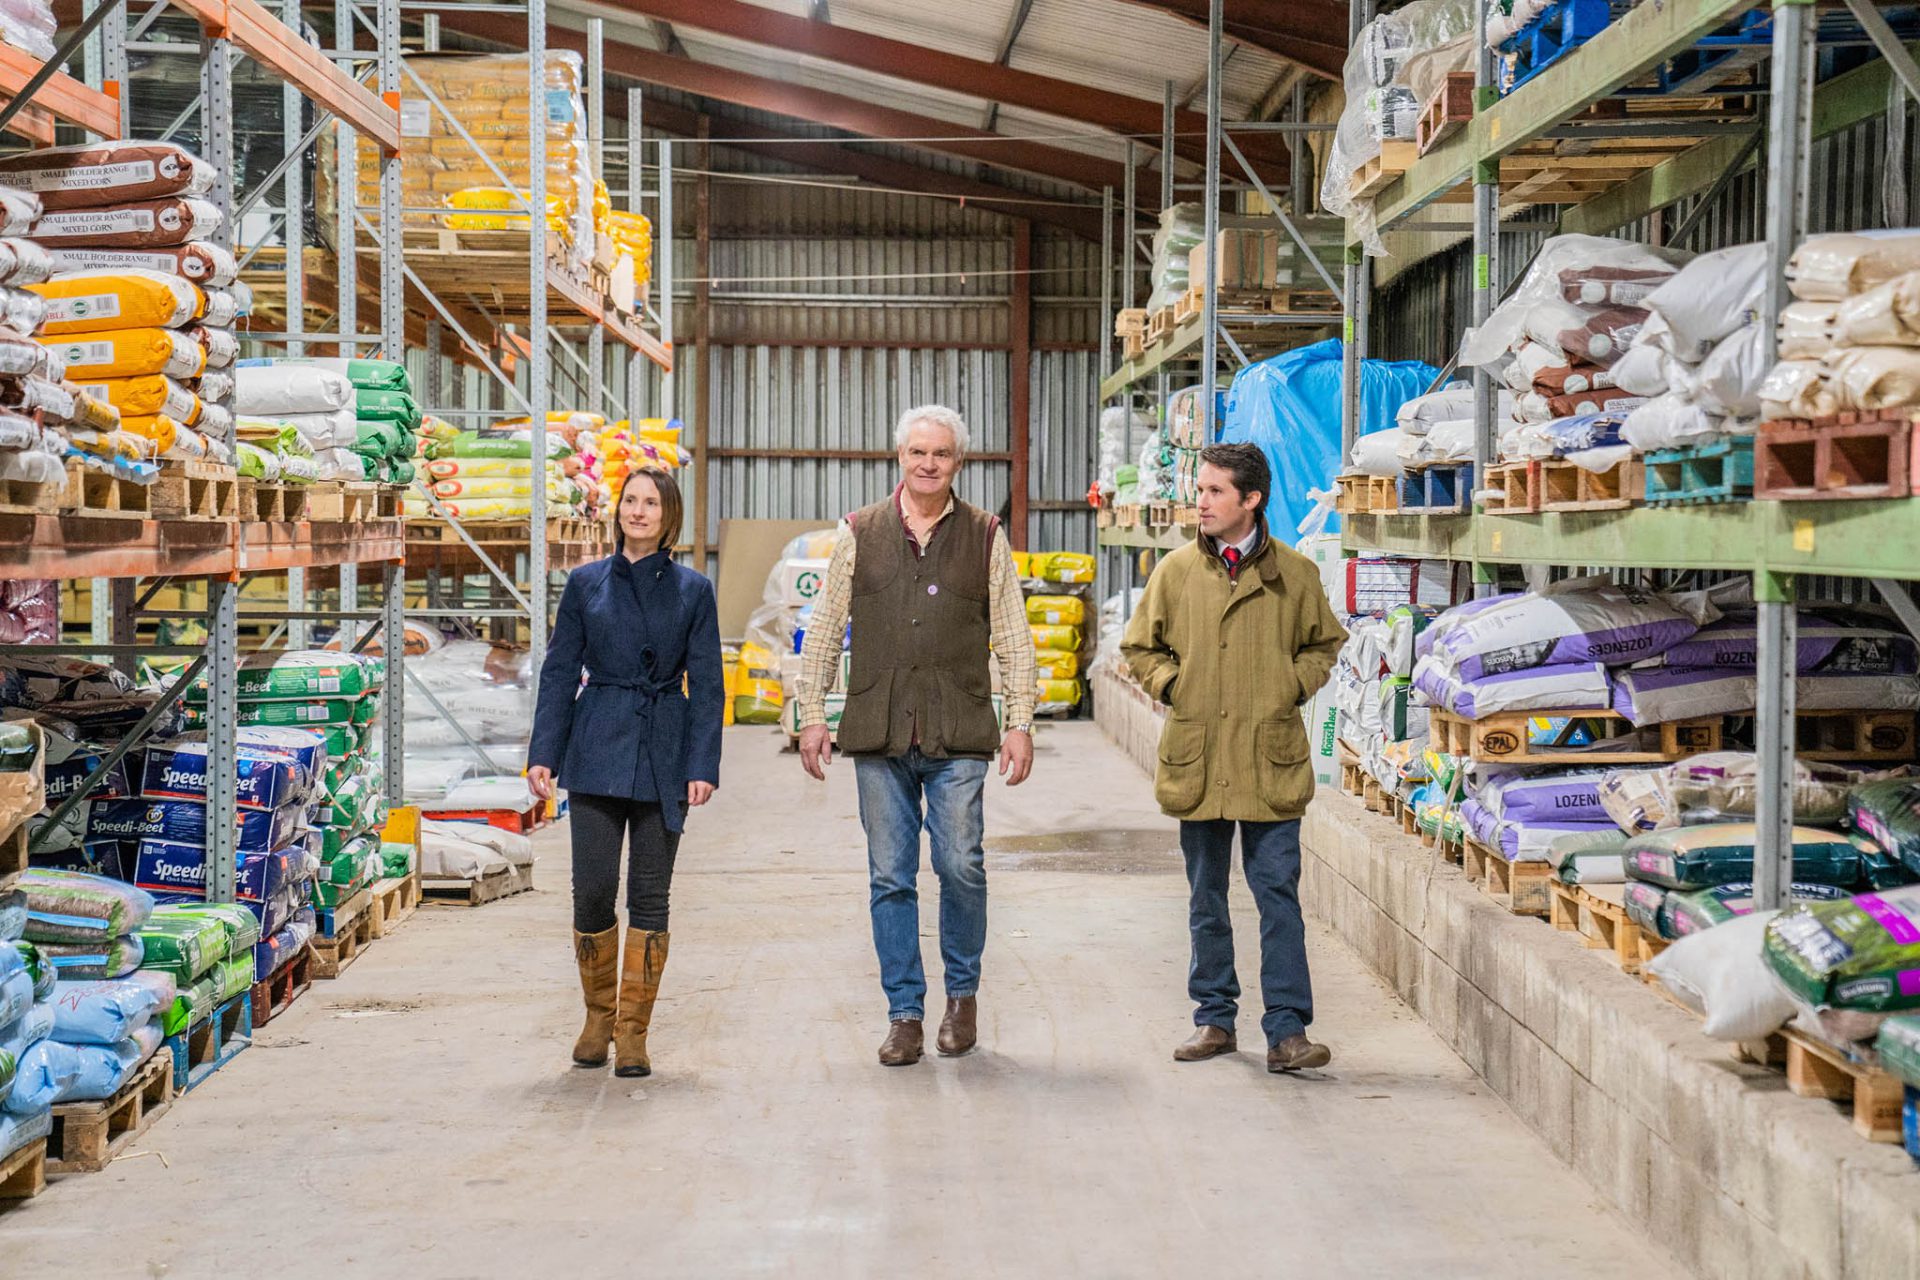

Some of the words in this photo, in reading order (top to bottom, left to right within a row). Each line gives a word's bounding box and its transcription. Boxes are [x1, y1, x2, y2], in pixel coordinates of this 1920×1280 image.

[40, 169, 68, 179] SMALL
[68, 167, 102, 178] HOLDER
[101, 164, 130, 175] RANGE
[61, 179, 90, 188] MIXED
[90, 177, 112, 186] CORN
[40, 214, 69, 225] SMALL
[69, 213, 104, 223] HOLDER
[103, 211, 130, 221] RANGE
[61, 225, 89, 234] MIXED
[90, 223, 113, 233] CORN
[63, 252, 88, 261] SMALL
[88, 254, 123, 263] HOLDER
[125, 255, 153, 264] RANGE
[1587, 636, 1654, 658] LOZENGES
[1486, 653, 1515, 667] Ansons
[1715, 651, 1757, 665] LOZEN
[1859, 661, 1889, 670] Ansons
[1485, 736, 1511, 750] EPAL
[91, 818, 165, 835] Speedi-Beet
